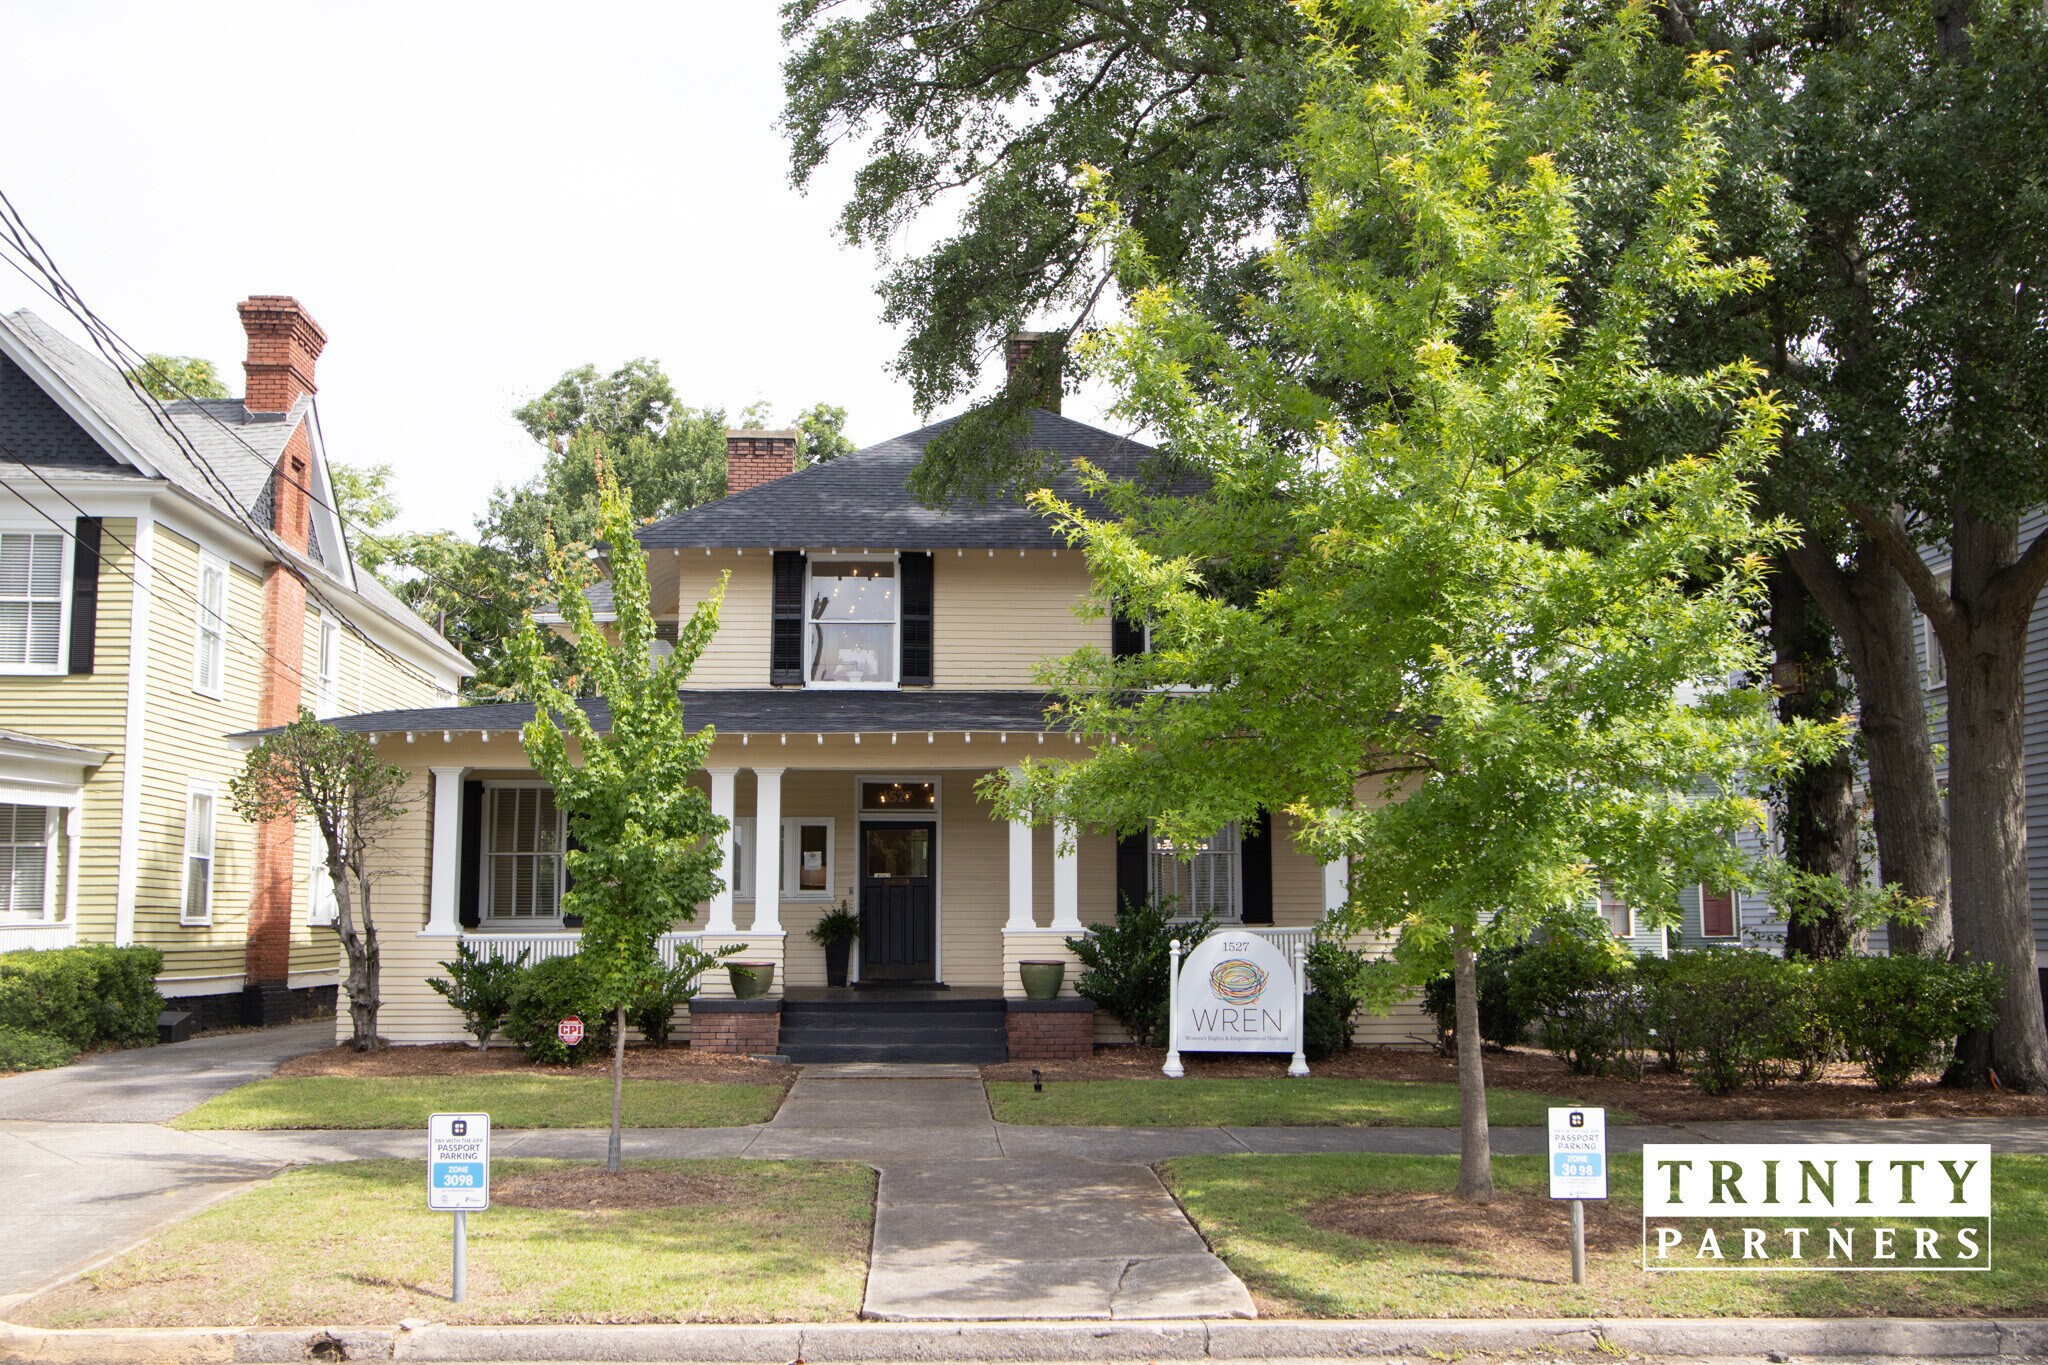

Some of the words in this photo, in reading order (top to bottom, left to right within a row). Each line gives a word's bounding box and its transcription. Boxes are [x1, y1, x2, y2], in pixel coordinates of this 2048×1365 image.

[1222, 941, 1250, 952] 1527
[1192, 1008, 1282, 1032] WREN
[560, 1025, 582, 1035] CPI
[440, 1152, 478, 1160] PARKING
[1561, 1163, 1594, 1176] 3098
[444, 1174, 474, 1186] 3098
